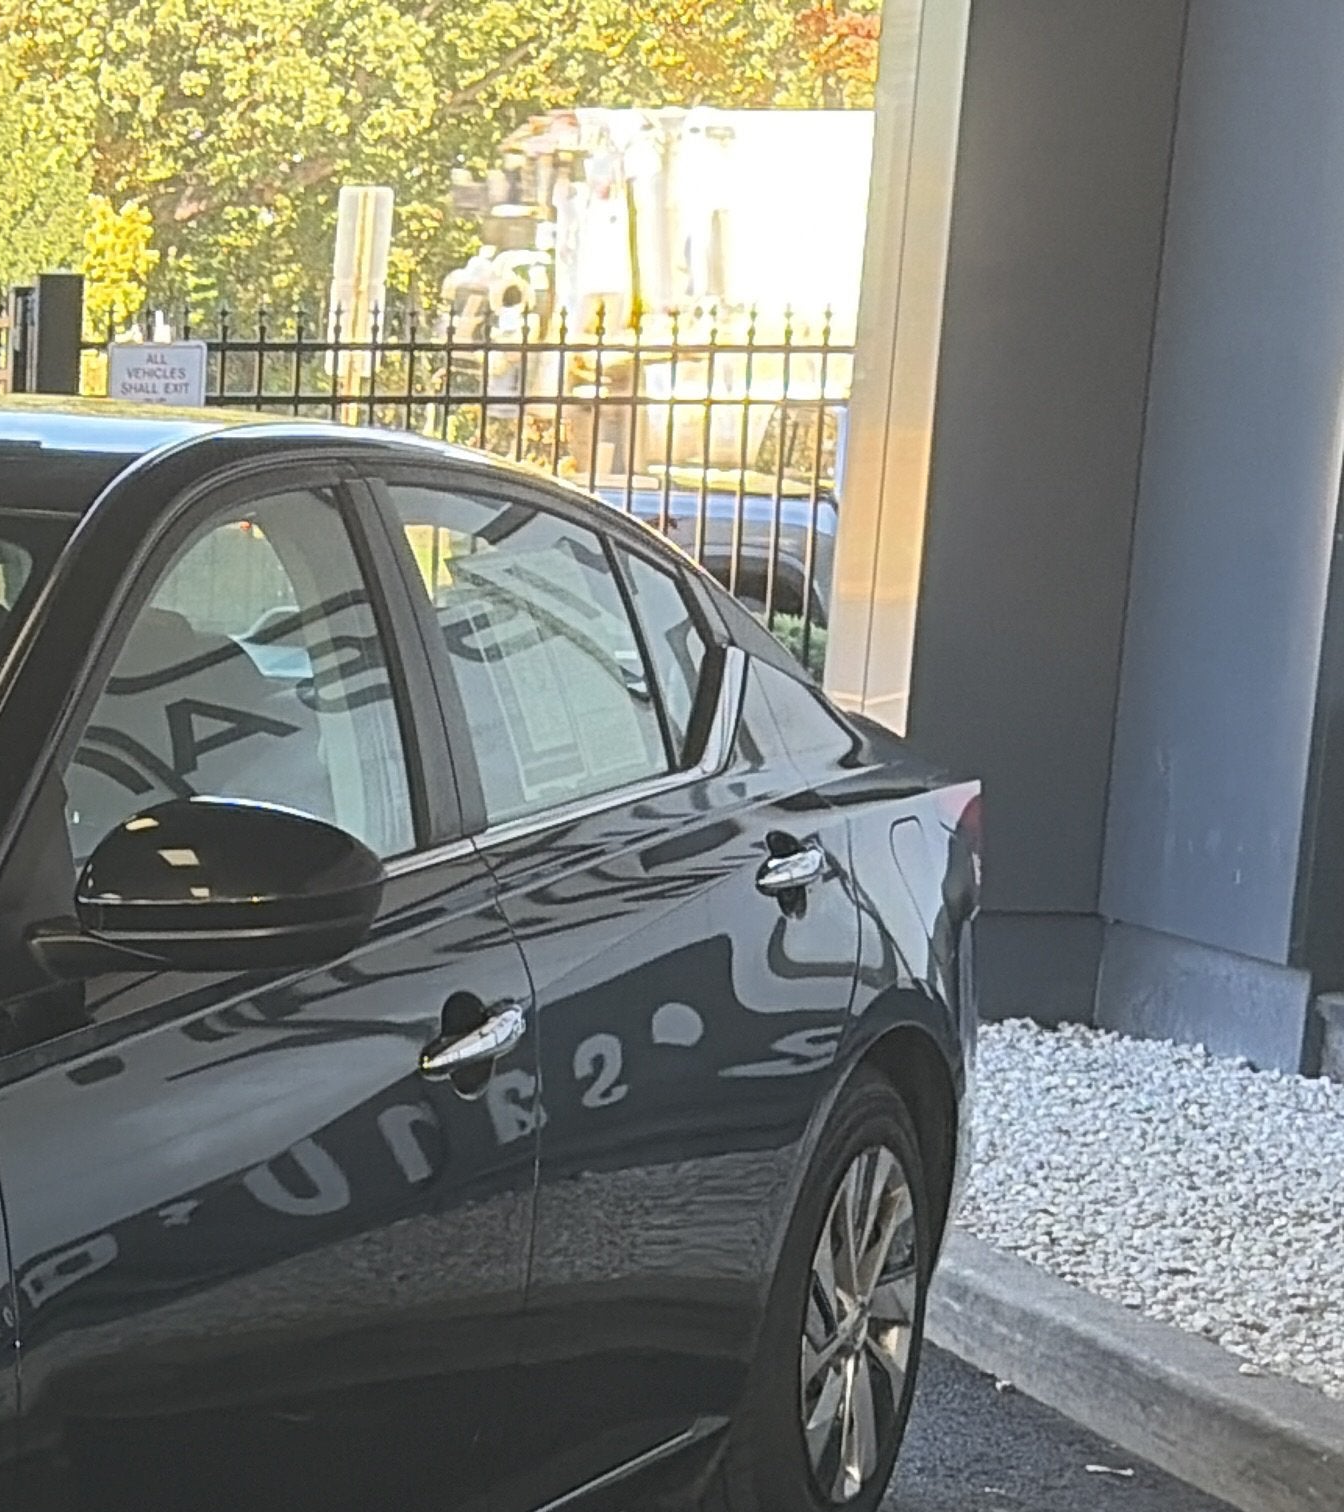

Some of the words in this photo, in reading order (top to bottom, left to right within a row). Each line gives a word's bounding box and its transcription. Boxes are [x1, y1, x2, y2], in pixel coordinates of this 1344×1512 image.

[146, 353, 167, 364] ALL
[126, 367, 186, 379] VEHICLES
[120, 382, 158, 395] SHALL
[164, 382, 190, 394] EXIT
